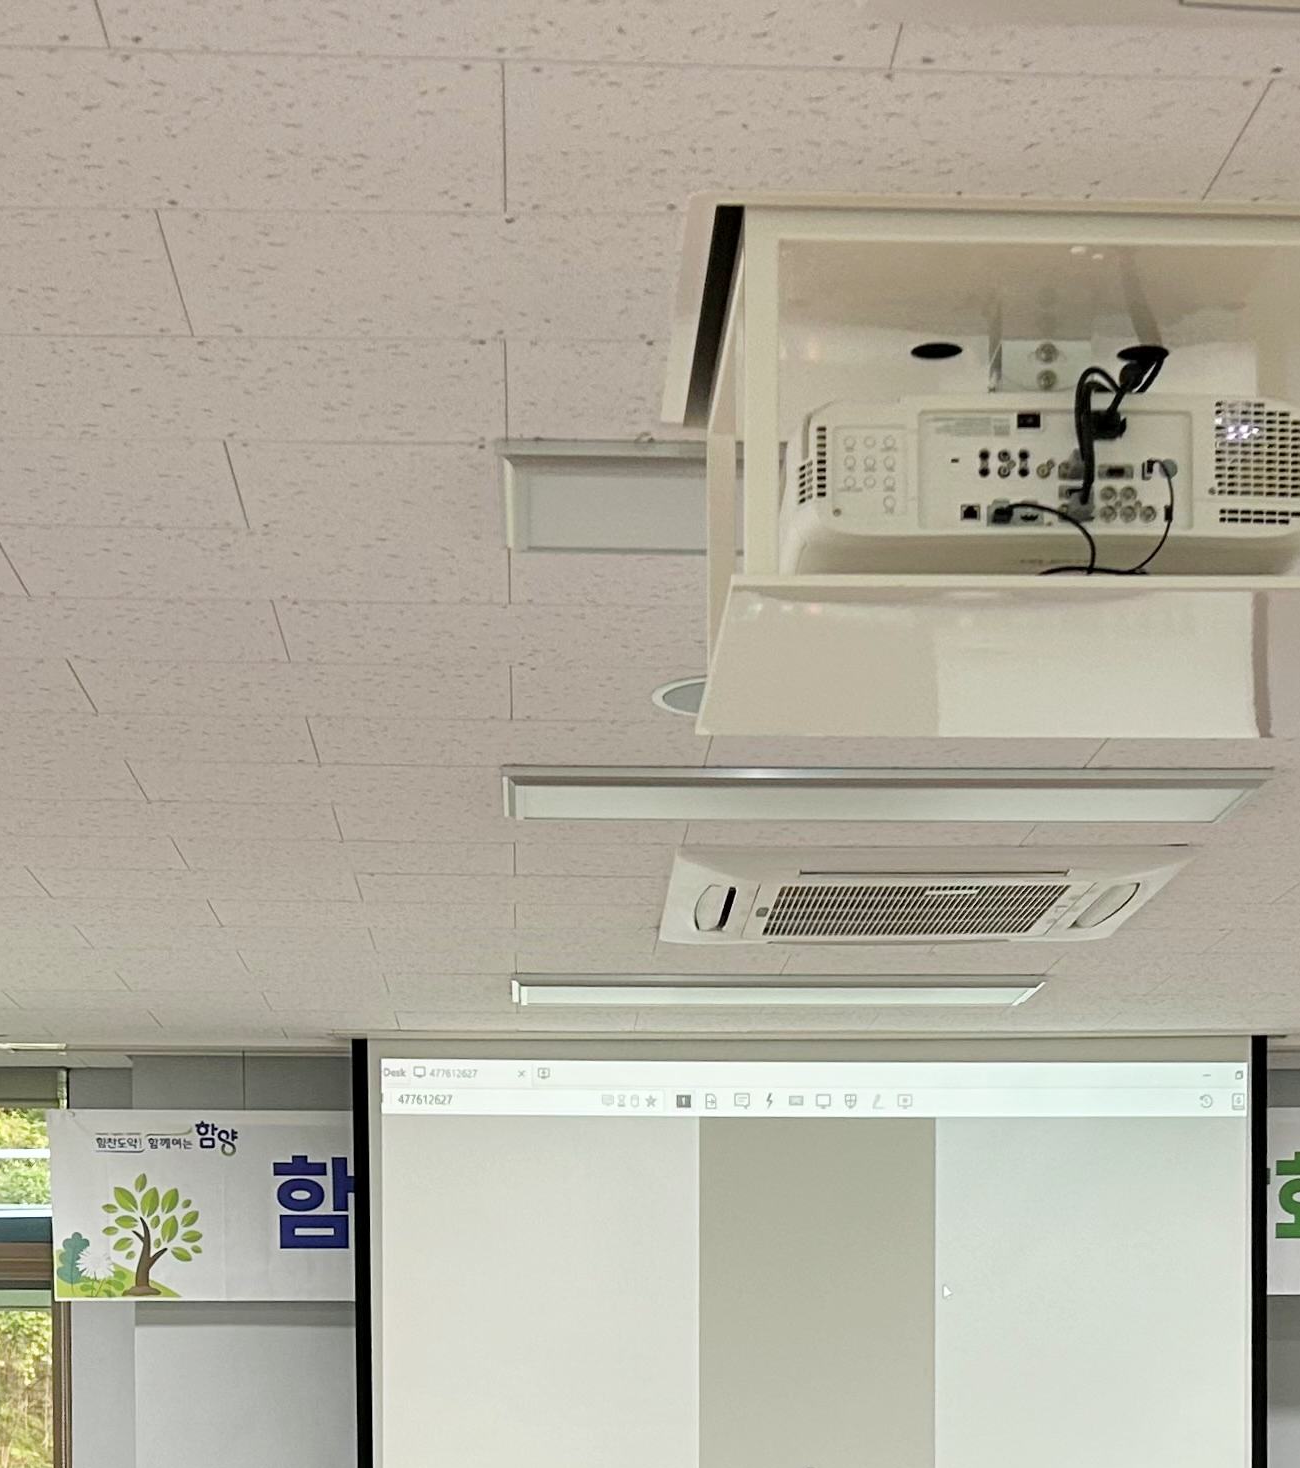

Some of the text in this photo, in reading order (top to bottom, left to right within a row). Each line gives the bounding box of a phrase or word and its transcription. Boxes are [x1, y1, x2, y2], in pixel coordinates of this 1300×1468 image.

[398, 1094, 453, 1106] 477612627
[148, 1137, 193, 1150] 함께여는
[195, 1120, 239, 1156] 함양
[272, 1155, 355, 1249] 함
